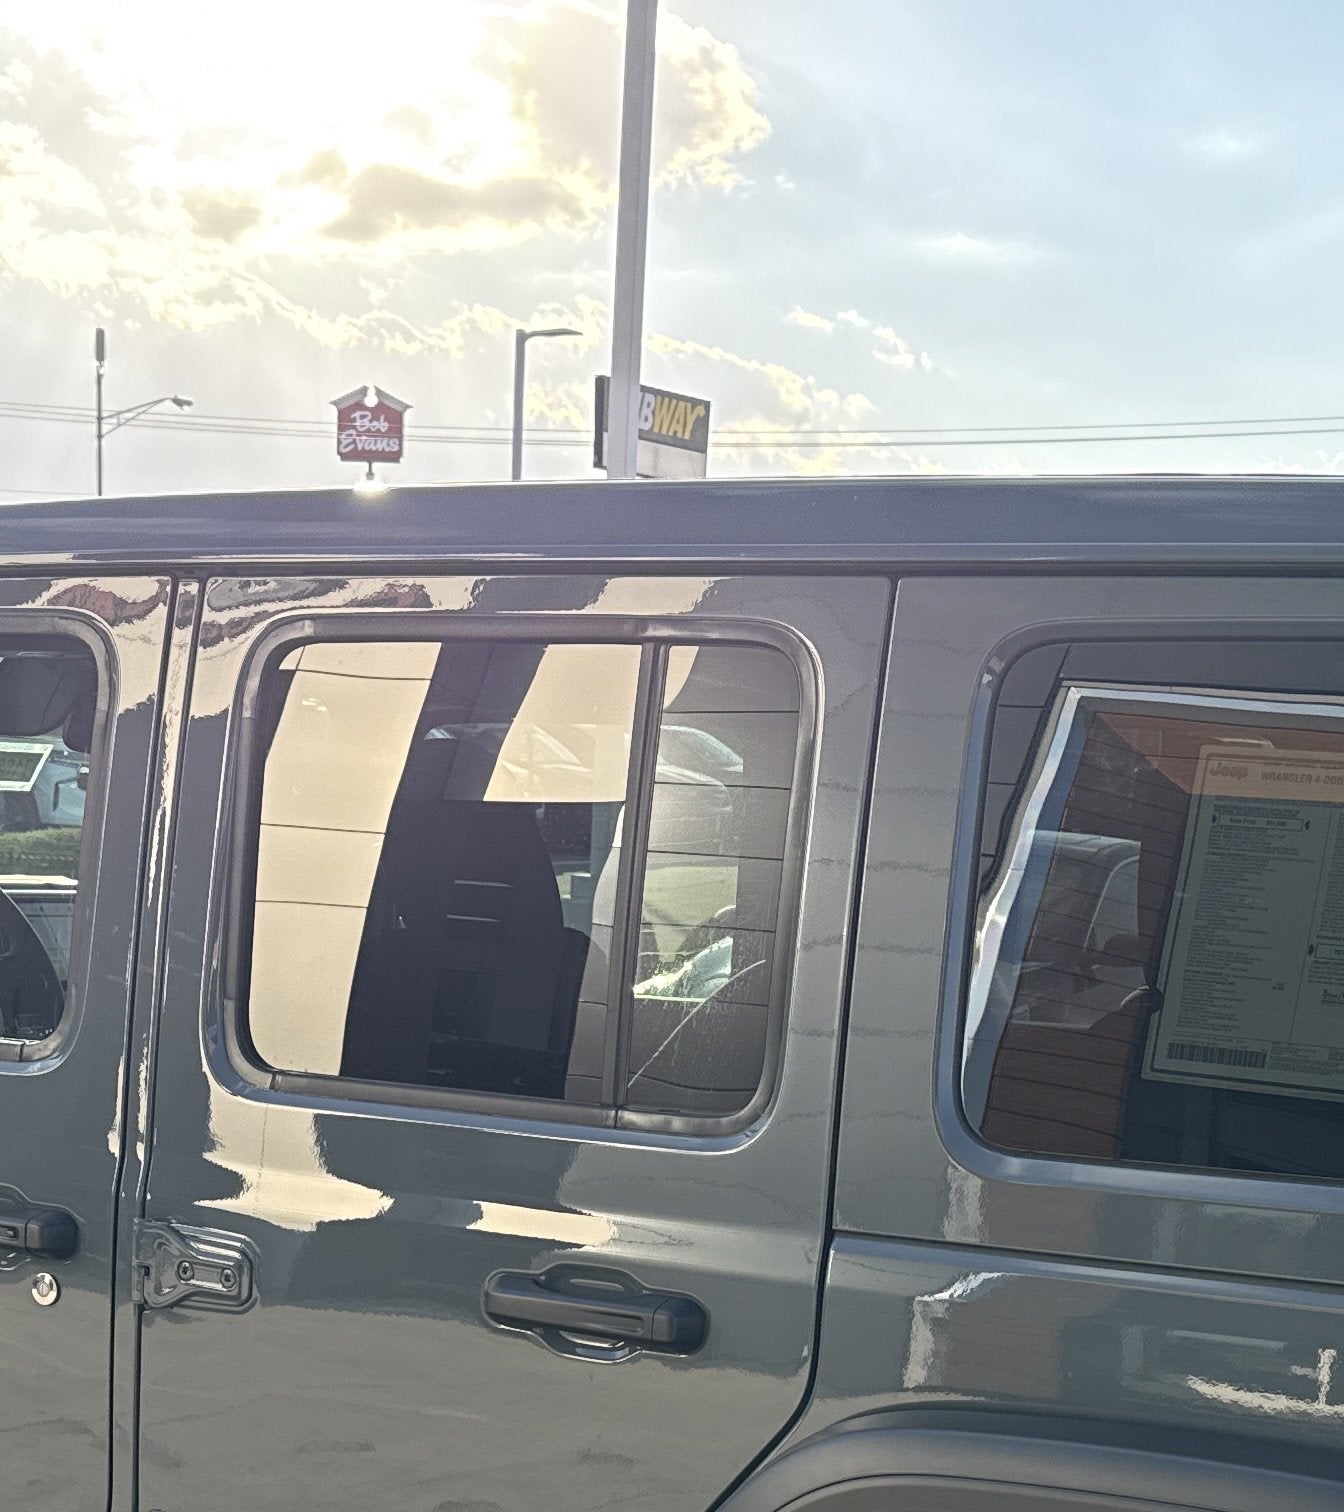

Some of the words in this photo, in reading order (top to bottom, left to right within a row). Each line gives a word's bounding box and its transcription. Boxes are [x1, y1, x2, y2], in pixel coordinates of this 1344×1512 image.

[350, 410, 389, 433] Bob
[638, 391, 706, 440] BWAY
[338, 429, 400, 453] Evans
[1209, 762, 1249, 781] Jeep
[1260, 771, 1313, 785] WRANGLER
